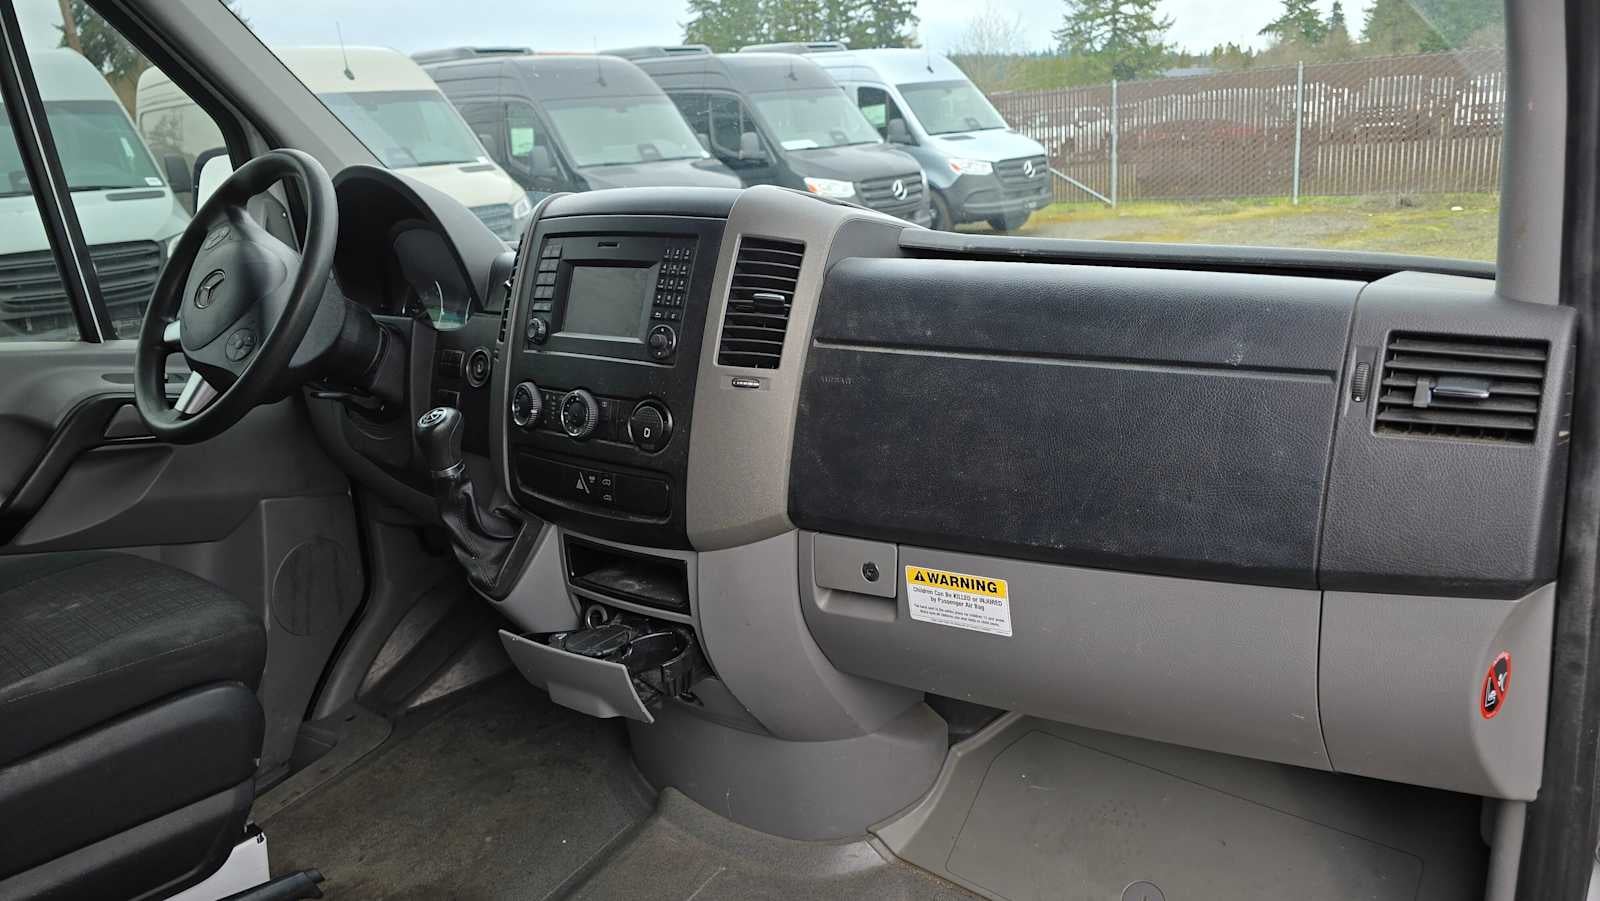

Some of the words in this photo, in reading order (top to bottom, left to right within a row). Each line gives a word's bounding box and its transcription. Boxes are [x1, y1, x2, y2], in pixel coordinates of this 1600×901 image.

[927, 572, 997, 594] WARNING
[913, 587, 933, 595] Children
[953, 592, 970, 601] KILLED
[979, 597, 1003, 606] INJURED
[938, 598, 964, 607] Passenger
